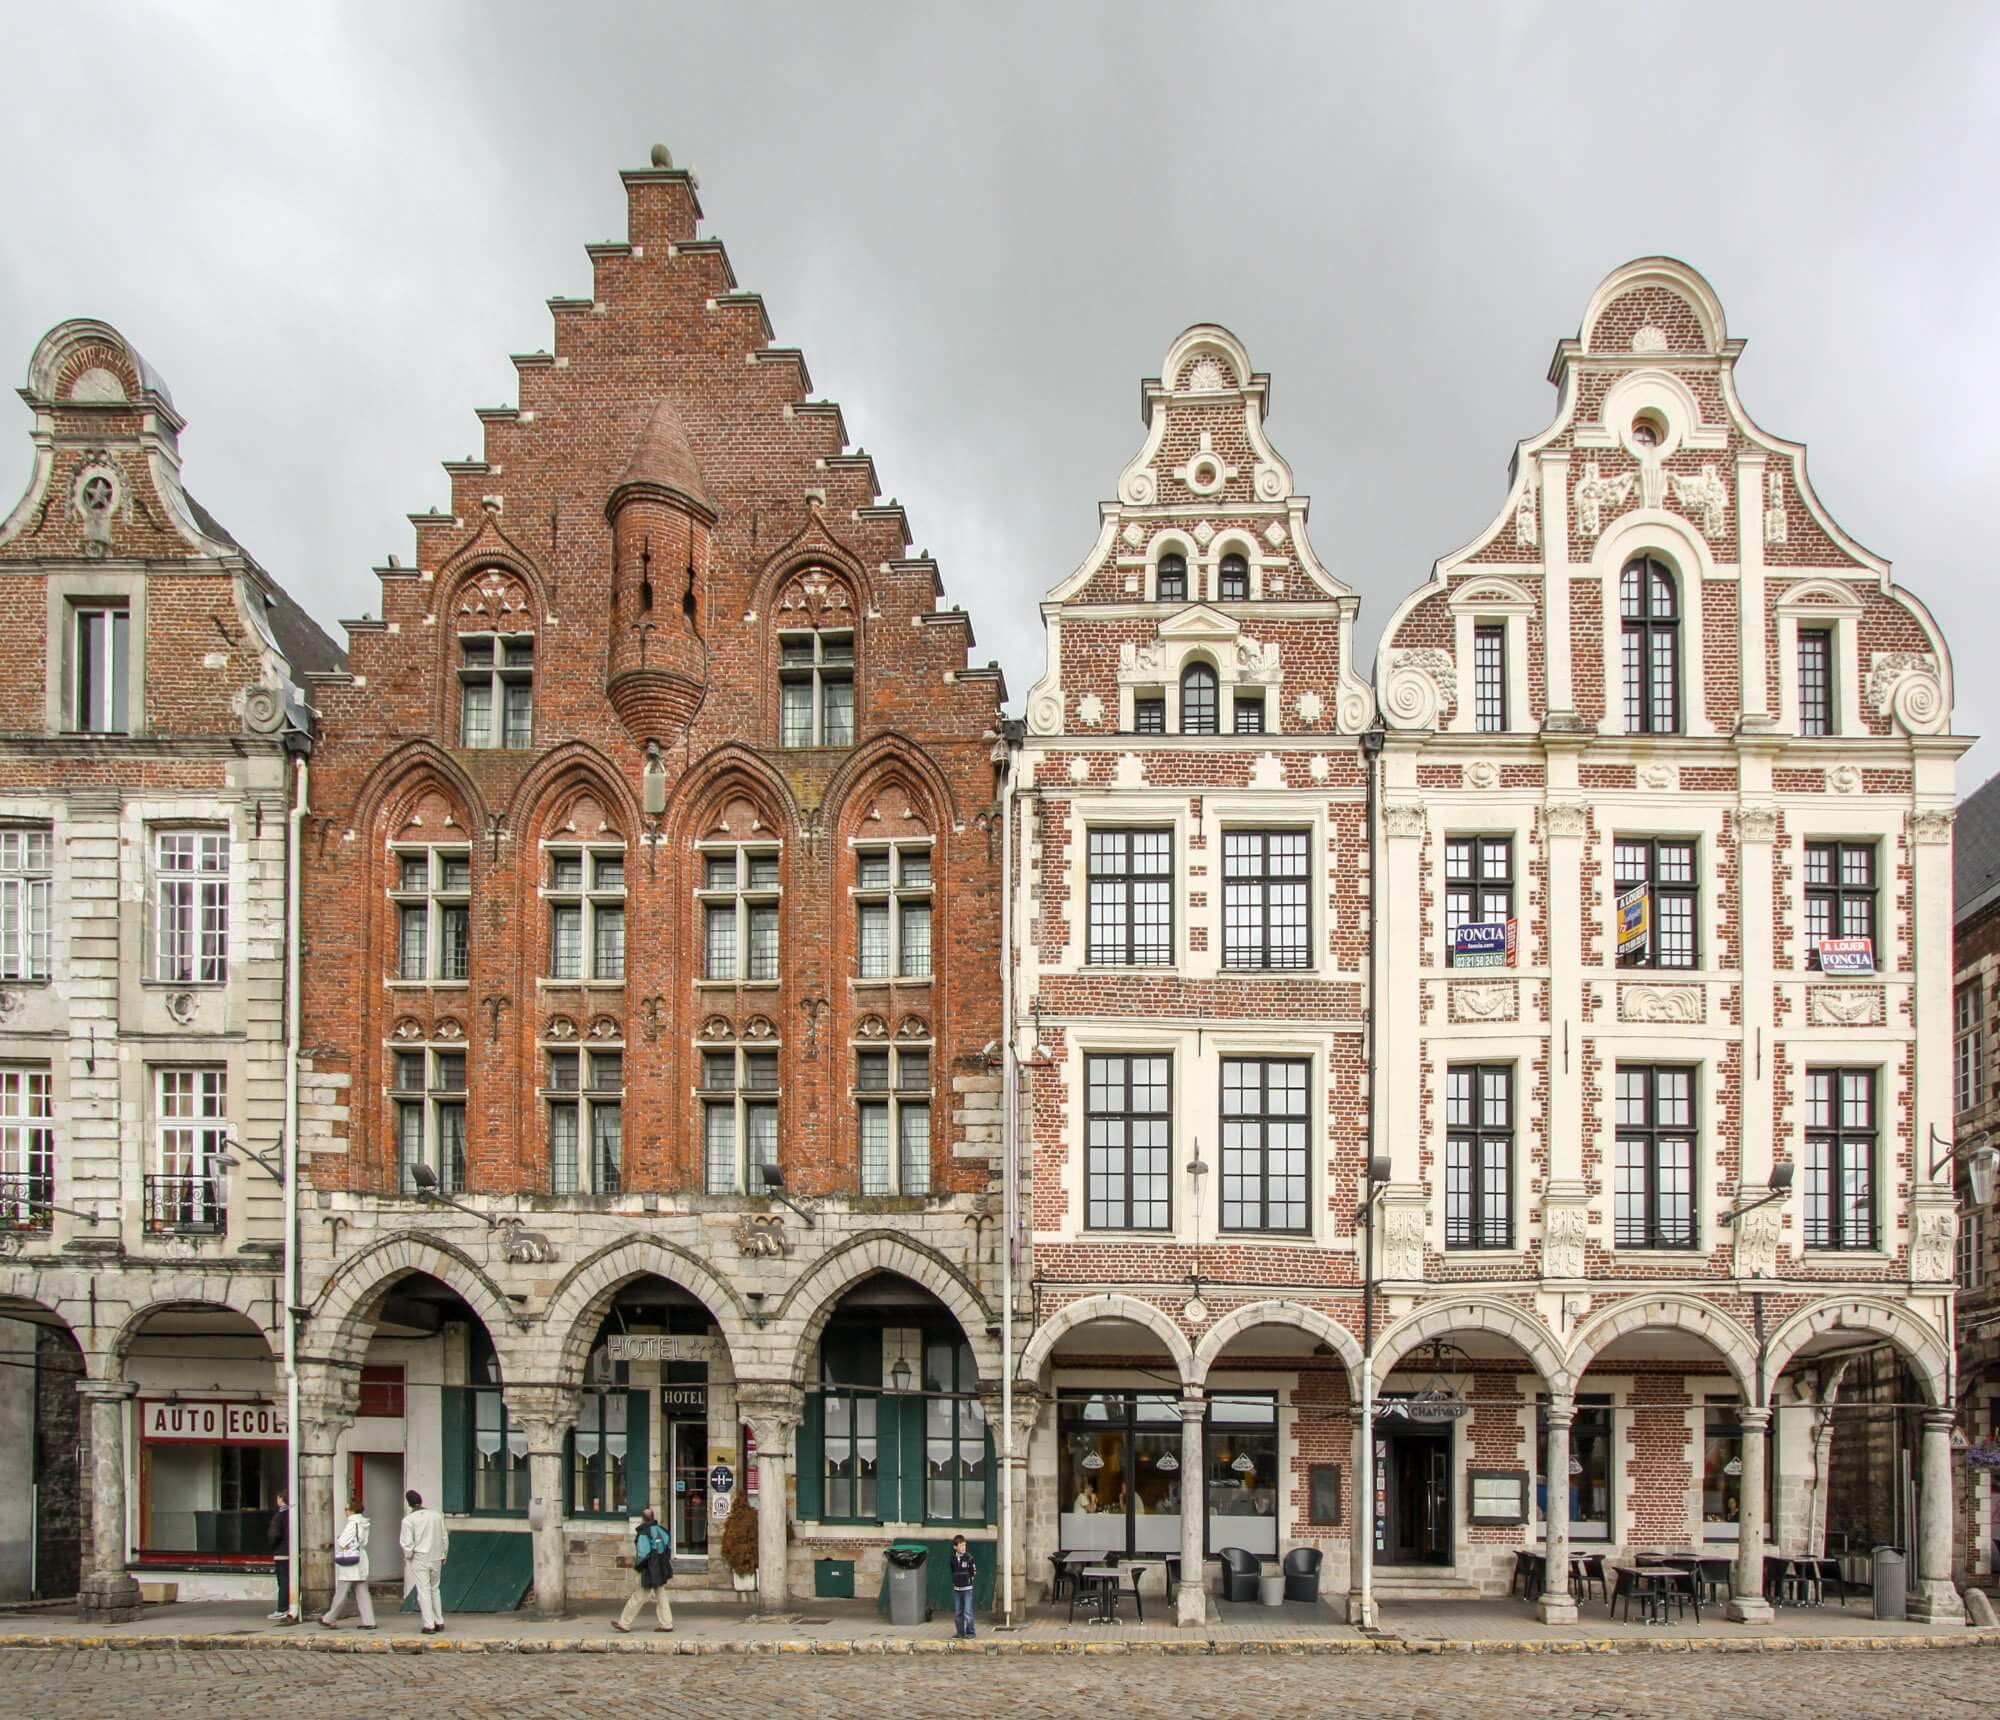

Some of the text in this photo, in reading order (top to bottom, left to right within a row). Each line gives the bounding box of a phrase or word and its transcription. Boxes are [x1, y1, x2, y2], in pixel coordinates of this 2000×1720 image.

[1457, 927, 1504, 941] FONCIA
[1824, 942, 1865, 951] A LOUER
[1823, 954, 1870, 965] FONCIA
[607, 1335, 685, 1360] HOTEL
[664, 1391, 705, 1404] HOTEL
[155, 1409, 289, 1433] AUTO ECOL
[718, 1474, 725, 1485] H
